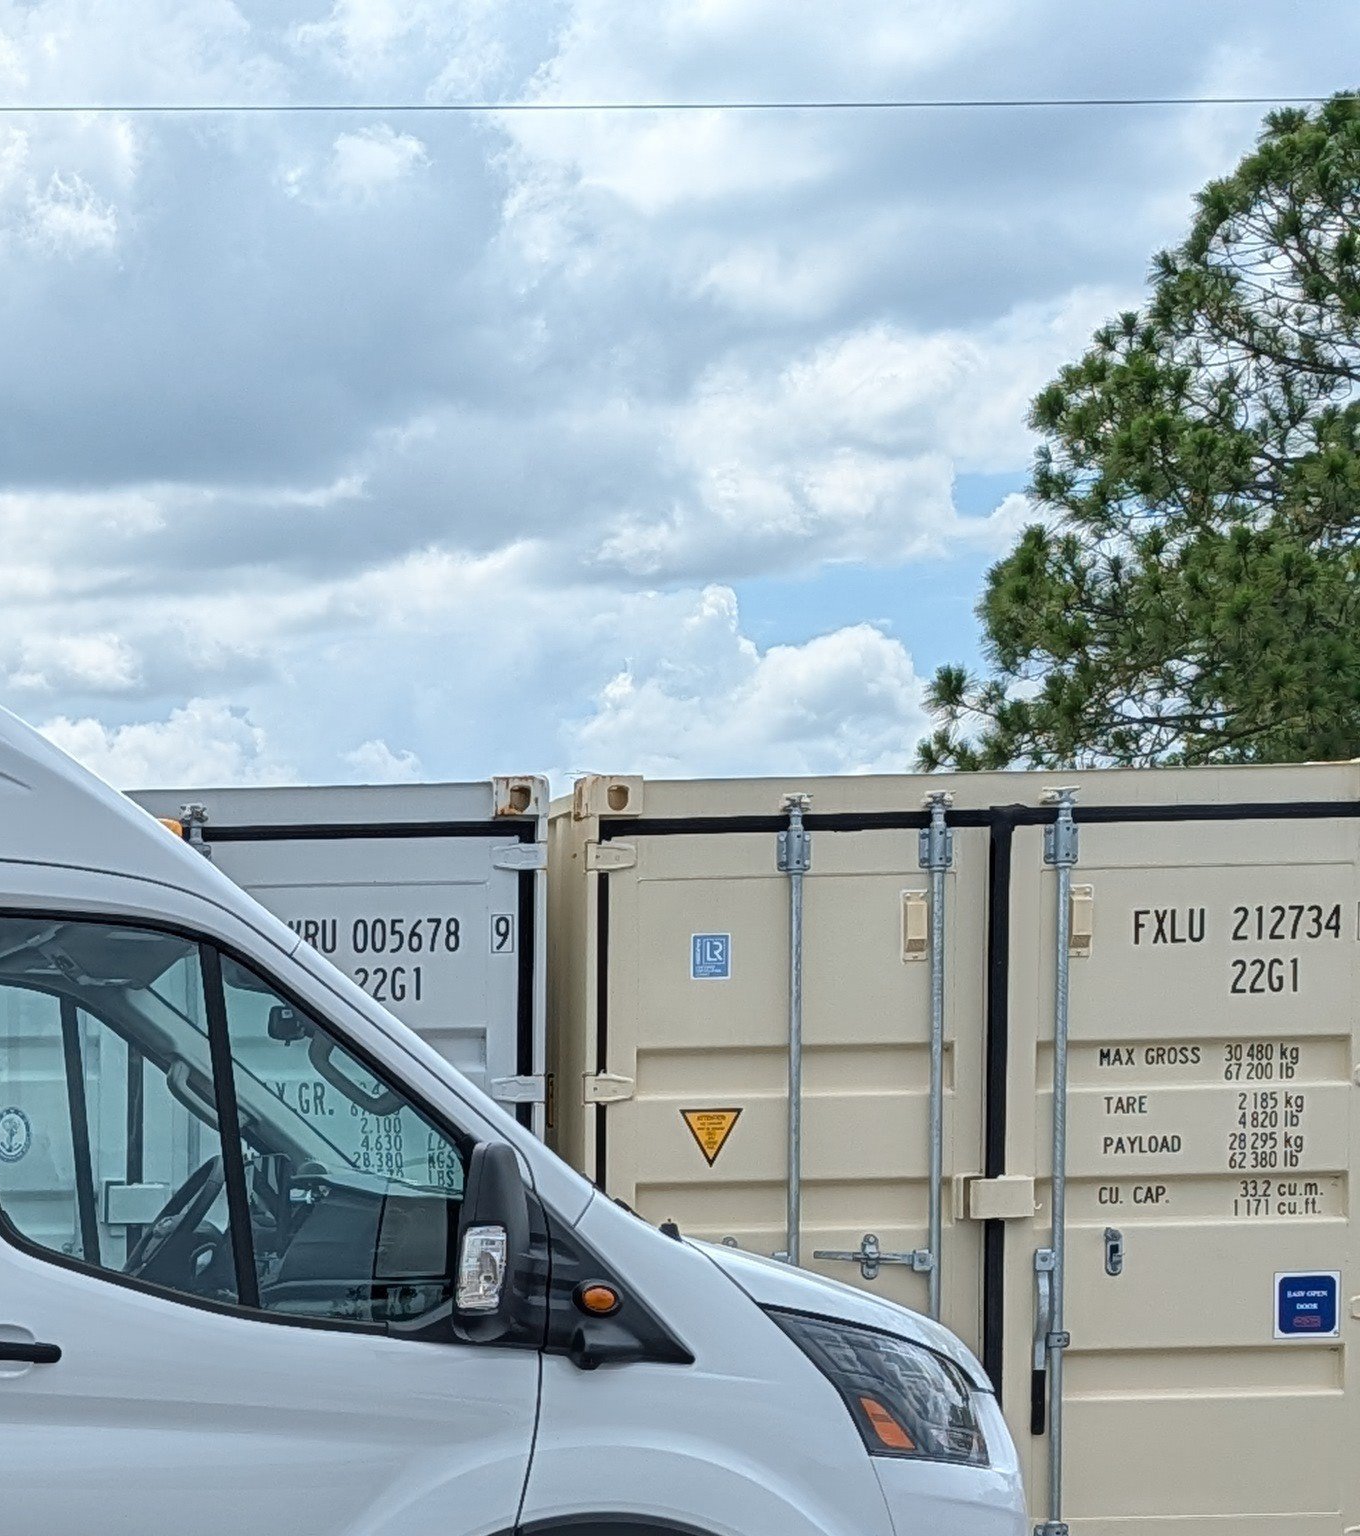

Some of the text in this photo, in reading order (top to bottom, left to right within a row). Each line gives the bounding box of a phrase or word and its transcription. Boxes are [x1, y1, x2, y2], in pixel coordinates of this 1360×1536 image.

[353, 918, 460, 953] 005678
[495, 916, 510, 950] 9
[1134, 904, 1341, 945] FXLU 212734
[354, 966, 422, 1002] 22G1
[1230, 957, 1299, 993] 22G1
[1099, 1048, 1135, 1067] MAX
[1145, 1047, 1201, 1066] GROSS
[1280, 1043, 1300, 1065] kg
[1279, 1062, 1295, 1079] lb
[298, 1081, 334, 1116] GR.
[1104, 1095, 1148, 1115] TARE
[1284, 1091, 1305, 1112] kg
[360, 1117, 402, 1134] 2.100
[1284, 1110, 1299, 1127] lb
[360, 1134, 403, 1152] 4.630
[1103, 1135, 1182, 1155] PAYLOAD
[1283, 1131, 1304, 1152] kg
[352, 1151, 455, 1169] 28.380 KGS
[1283, 1150, 1299, 1167] lb
[1098, 1180, 1324, 1204] CU. CAP. 33.2 cu.m.
[1277, 1197, 1322, 1216] cu.ft.
